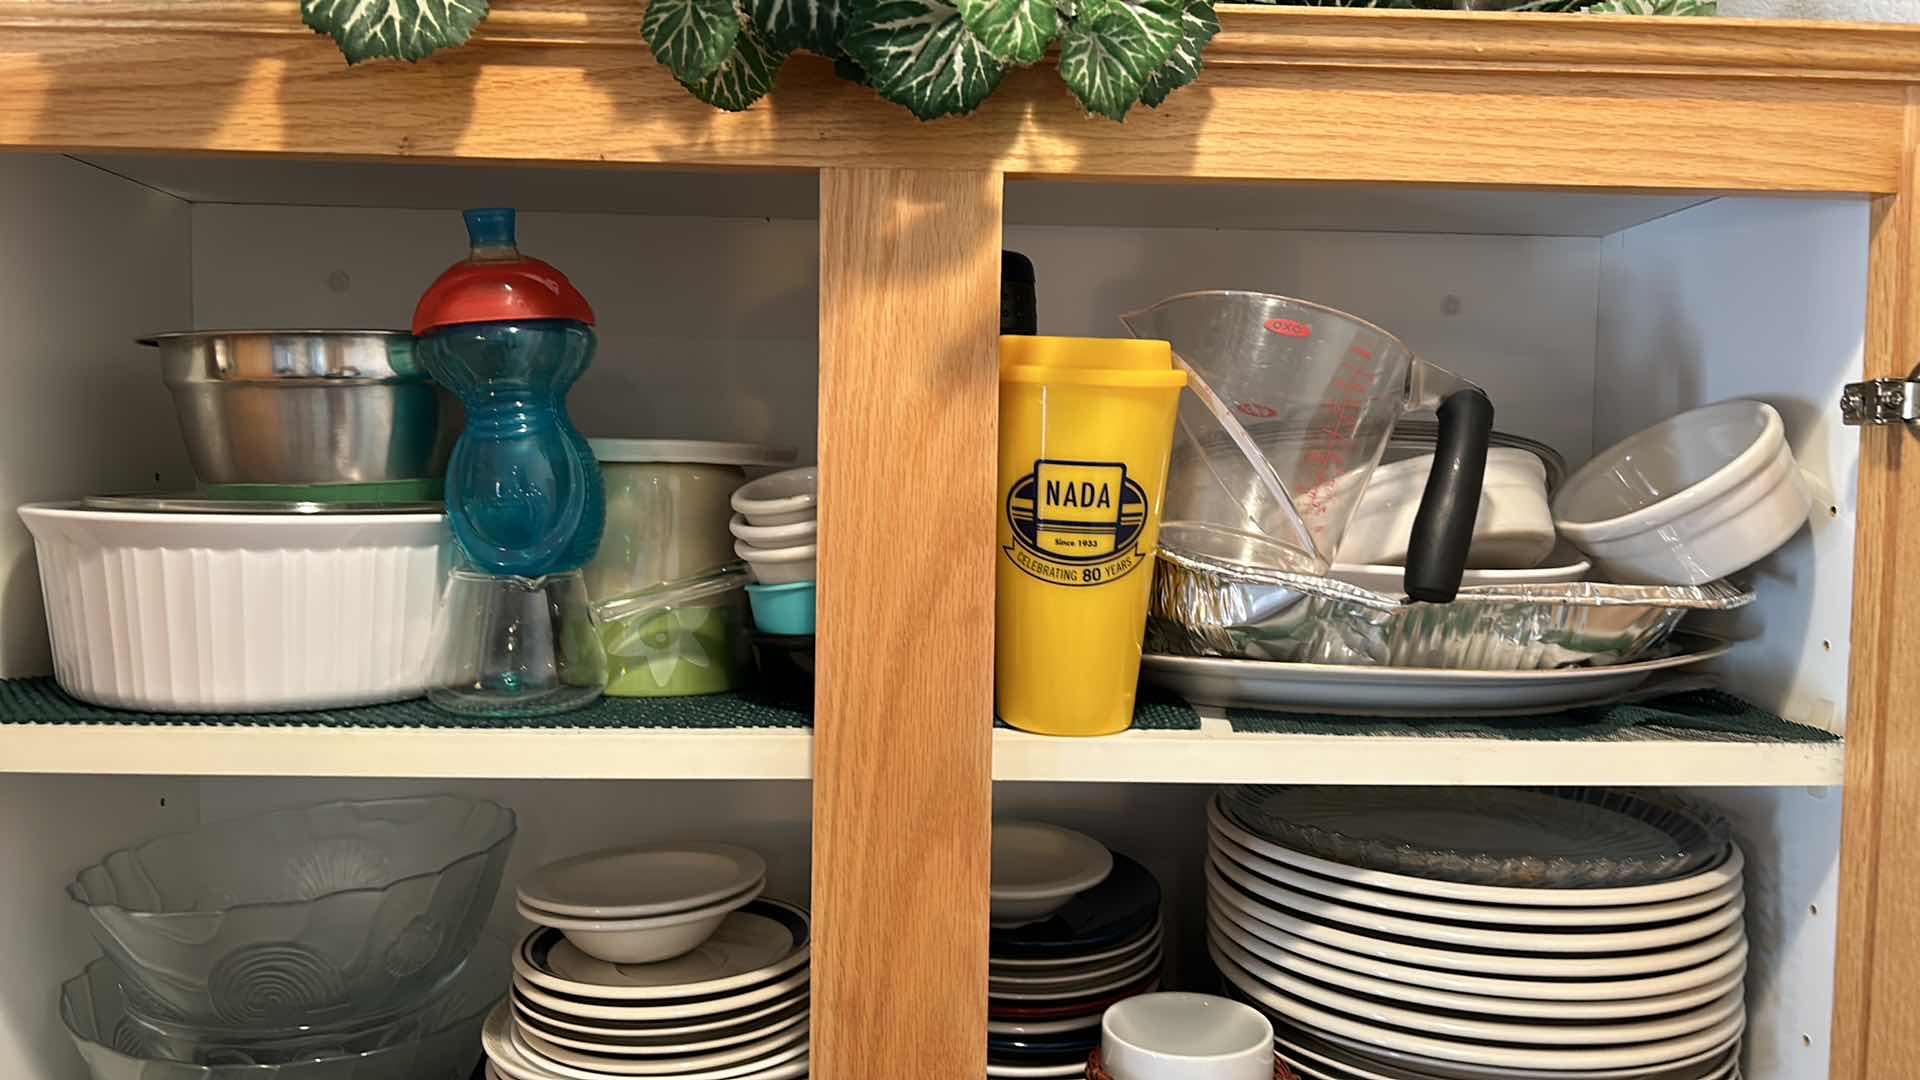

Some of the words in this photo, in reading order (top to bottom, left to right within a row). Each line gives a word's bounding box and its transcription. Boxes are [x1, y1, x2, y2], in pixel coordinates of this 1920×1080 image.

[1046, 479, 1111, 509] NADA
[1055, 538, 1075, 547] Since
[1078, 539, 1098, 548] 1933
[1016, 551, 1078, 582] CELEBRATING
[1082, 567, 1102, 583] 80
[1104, 556, 1133, 577] YEARS
